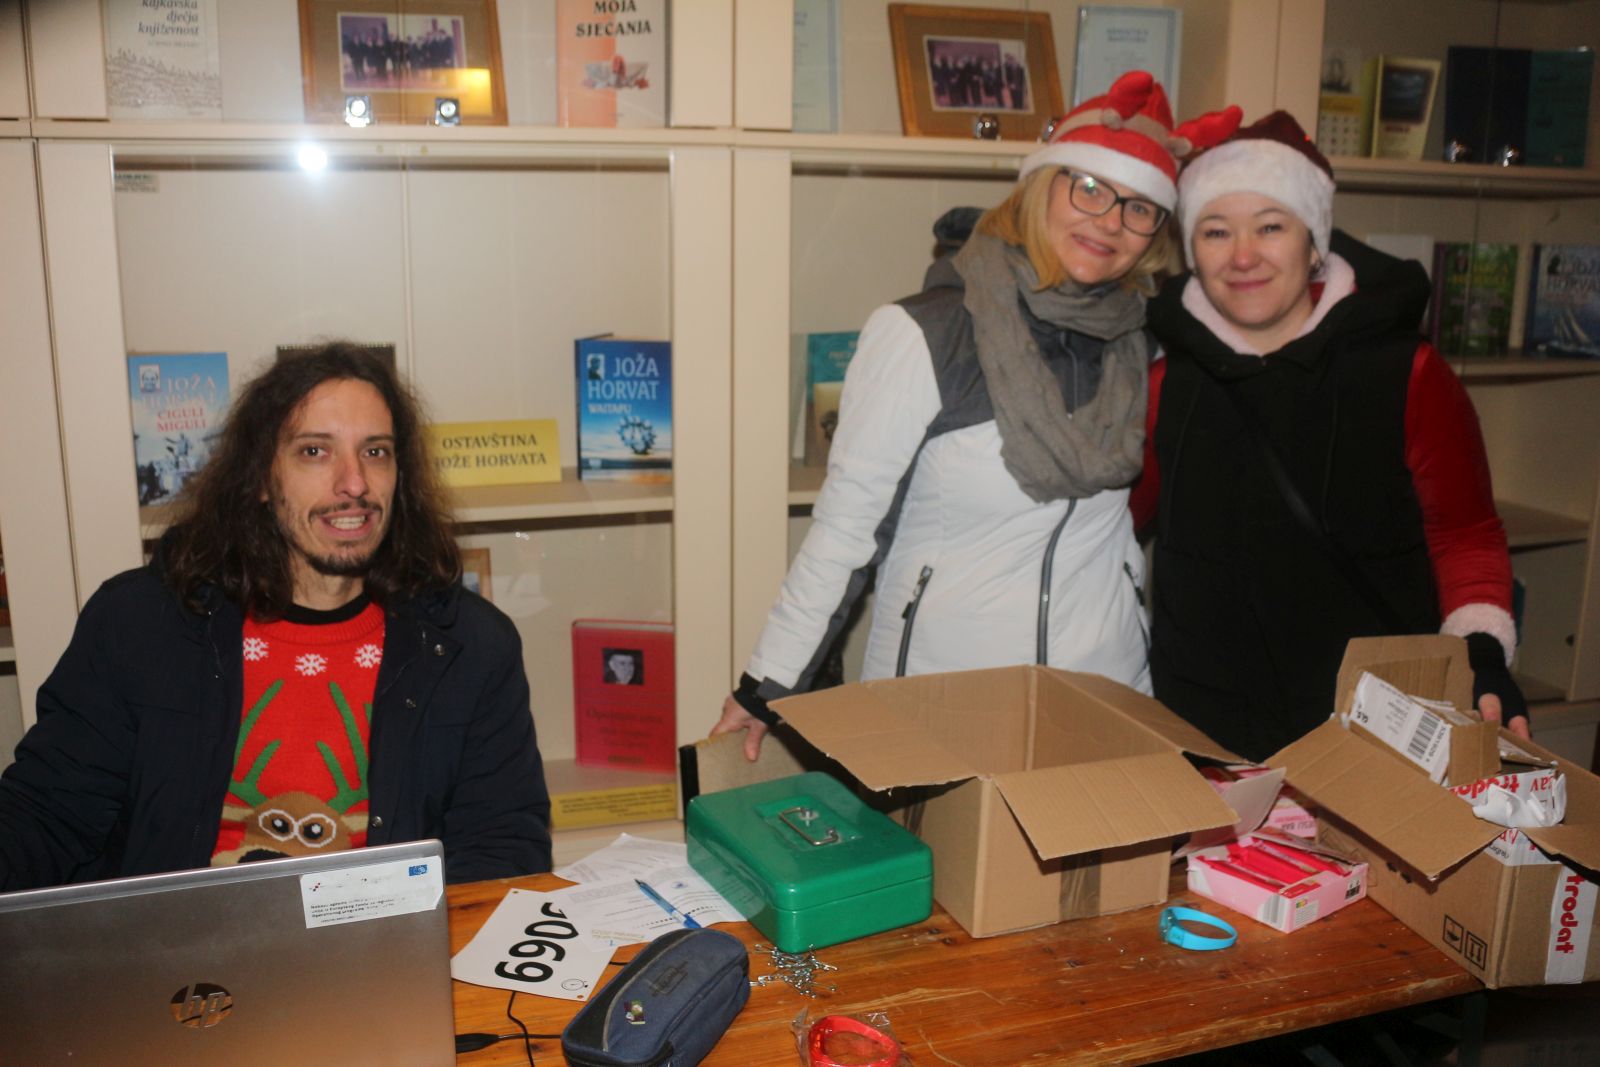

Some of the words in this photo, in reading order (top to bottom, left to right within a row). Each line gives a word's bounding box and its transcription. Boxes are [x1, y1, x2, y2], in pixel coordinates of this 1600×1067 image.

[594, 0, 637, 14] MOJA
[613, 353, 660, 378] JOŽA
[588, 380, 660, 400] HORVAT
[442, 433, 537, 450] OSTAVŠTINA
[475, 452, 547, 469] HORVATA
[1555, 874, 1586, 955] trodat
[175, 983, 229, 1029] hp
